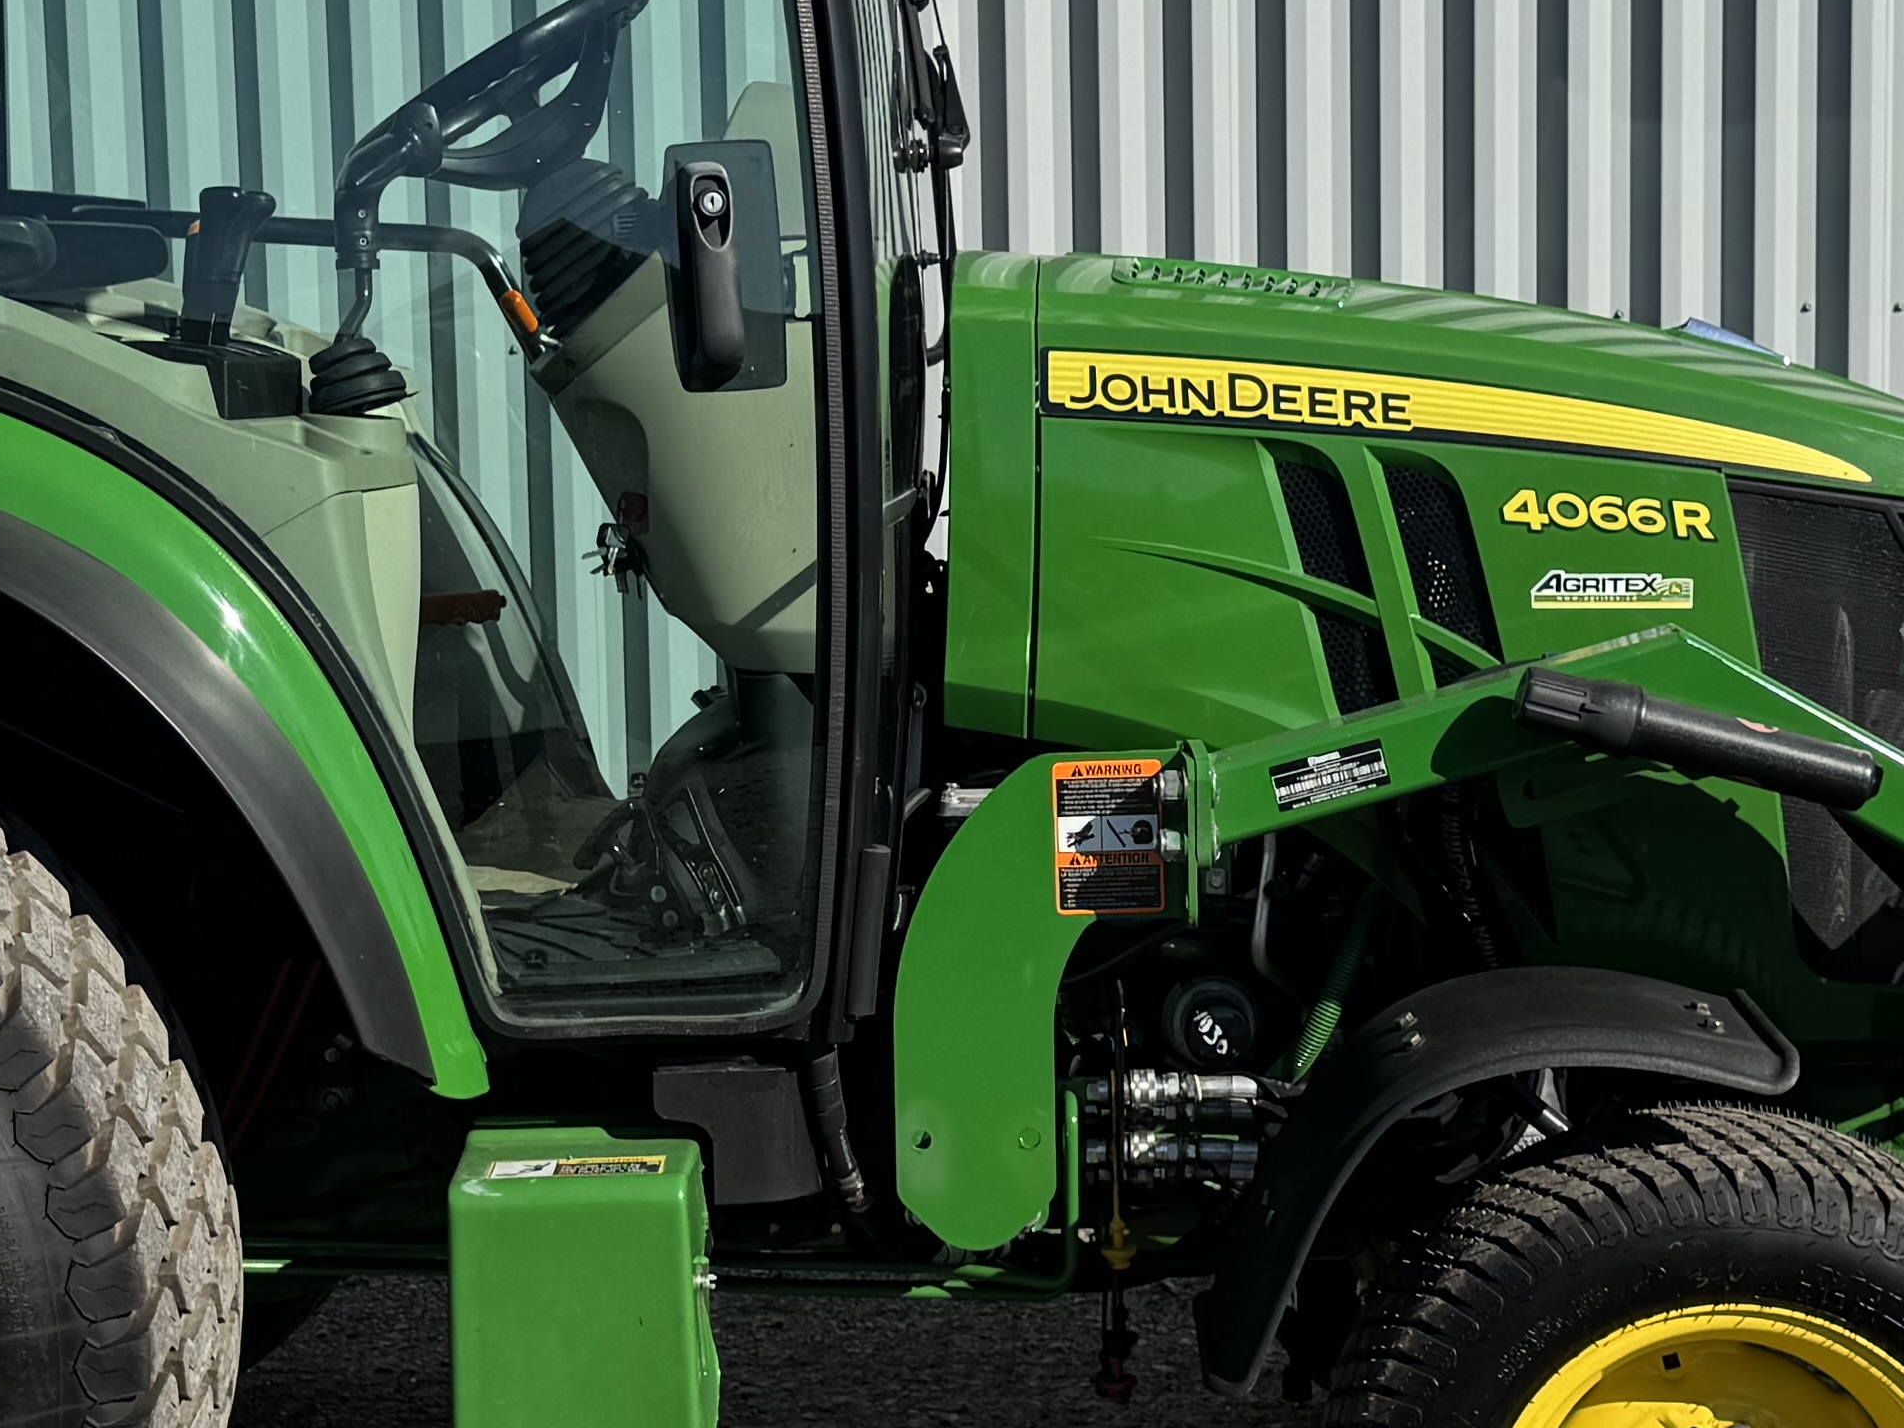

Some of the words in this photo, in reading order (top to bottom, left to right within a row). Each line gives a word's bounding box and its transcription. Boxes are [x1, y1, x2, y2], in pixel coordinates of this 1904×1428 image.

[1069, 365, 1216, 411] JOHN
[1228, 373, 1412, 426] DEERE
[1501, 488, 1668, 535] 4066
[1671, 499, 1716, 540] R
[1535, 573, 1659, 593] AGRITEX
[1084, 763, 1143, 776] WARNING
[1083, 852, 1150, 866] ATTENTION
